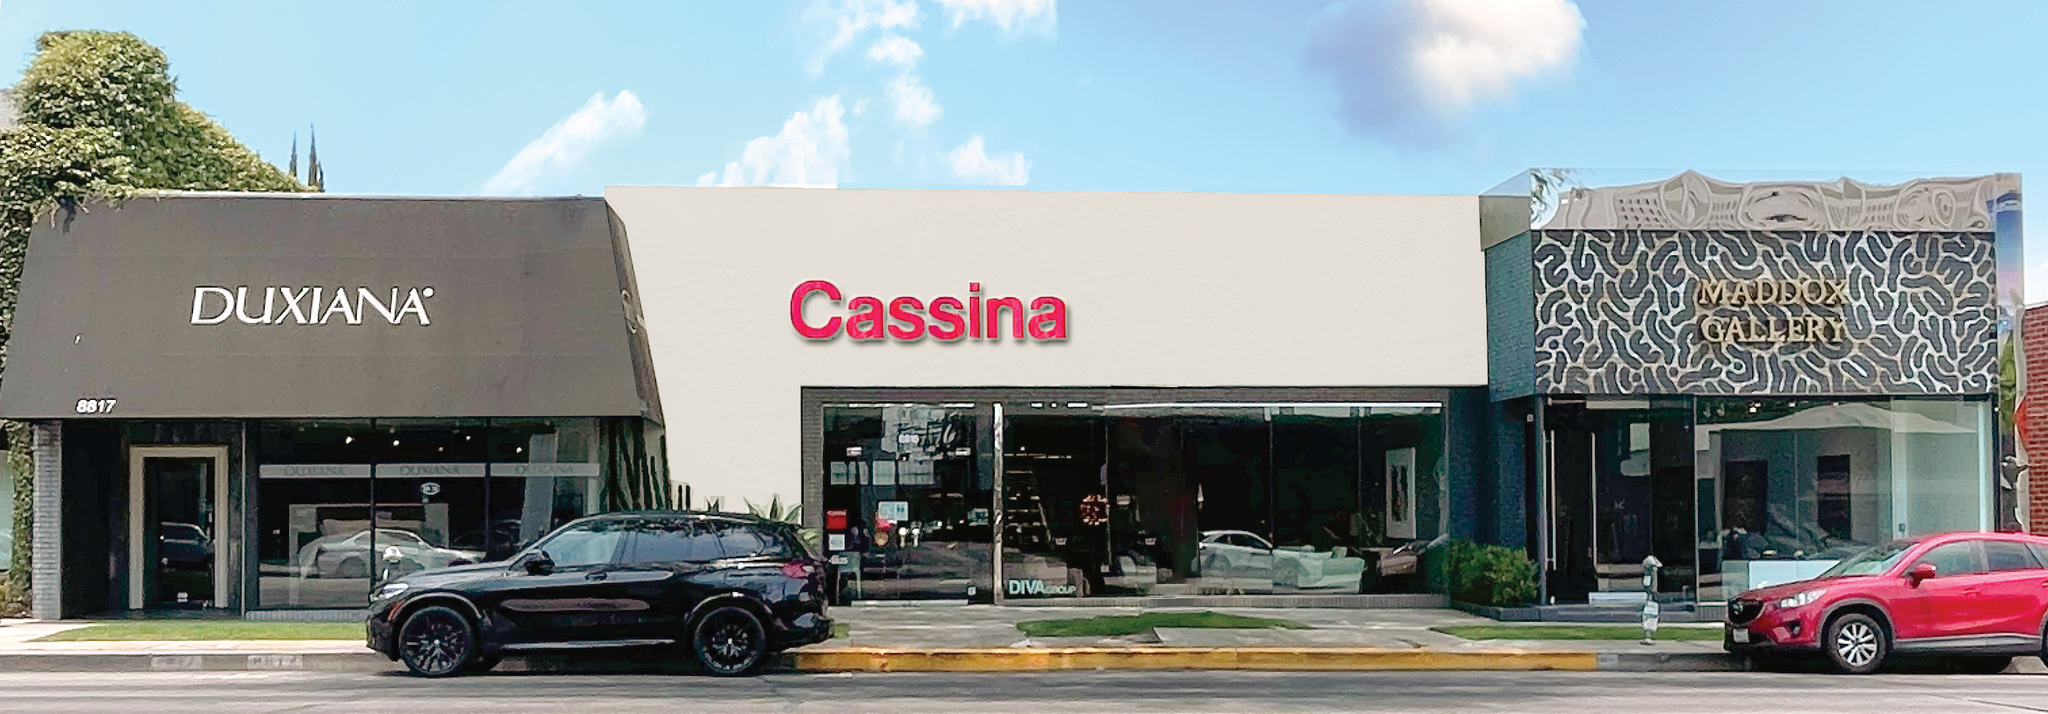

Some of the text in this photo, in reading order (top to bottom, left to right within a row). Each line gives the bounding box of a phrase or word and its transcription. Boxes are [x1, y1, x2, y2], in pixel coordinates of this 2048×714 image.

[1699, 279, 1848, 304] MADDOX
[191, 286, 433, 325] DUXIANA
[790, 279, 1067, 342] Cassina
[1701, 316, 1846, 342] GALLERY
[76, 399, 117, 413] 8817
